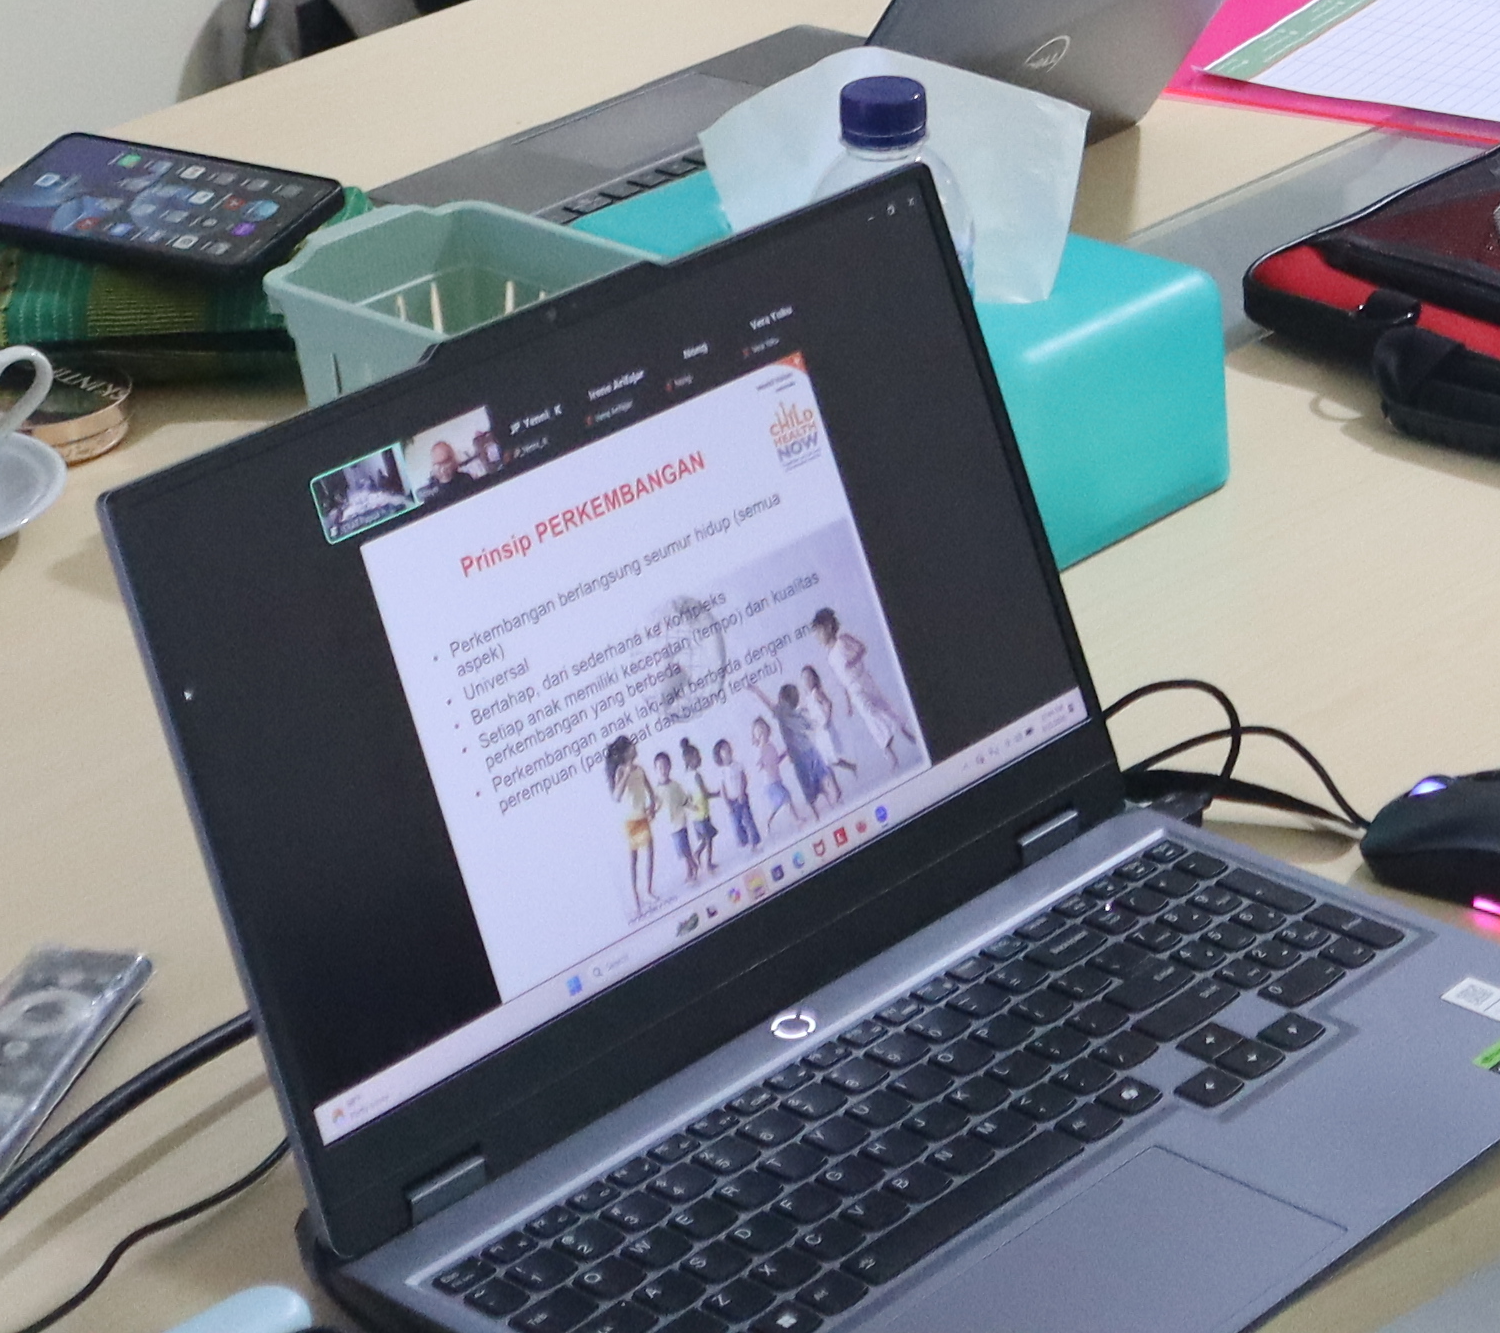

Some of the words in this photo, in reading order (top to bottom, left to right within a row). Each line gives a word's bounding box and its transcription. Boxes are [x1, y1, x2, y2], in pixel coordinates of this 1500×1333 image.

[777, 432, 818, 462] NOW
[449, 598, 555, 657] Perkembangan
[557, 558, 641, 607] berlangsung
[643, 533, 692, 567] seumur
[694, 516, 731, 543] hidup
[733, 493, 780, 527] (semua
[459, 534, 532, 577] Prinsip
[534, 450, 706, 543] PERKEMBANGAN
[457, 644, 506, 677] aspek)
[463, 658, 530, 701] Universal
[470, 686, 539, 726] Bertahap,
[542, 666, 569, 691] dari
[571, 632, 643, 677] sederhana
[644, 621, 662, 639] ke
[663, 592, 727, 631] kompleks
[478, 718, 525, 749] Setiap
[527, 700, 562, 727] anak
[564, 671, 619, 707] memiliki
[621, 636, 691, 678] kecepatan
[693, 609, 744, 646] (tempo)
[745, 597, 768, 618] dan
[770, 572, 820, 604] kualitas
[485, 711, 588, 772] perkembangan
[590, 692, 626, 720] yang
[626, 662, 683, 698] berbeda
[492, 732, 597, 792] Perkembangan
[600, 711, 634, 739] anak
[635, 685, 686, 720] laki-laki
[688, 657, 741, 695] berbeda
[744, 634, 792, 667] dengan
[499, 764, 578, 816] perempuan
[654, 711, 683, 733] dan
[682, 689, 728, 718] bidang
[728, 658, 784, 695] tertentu)
